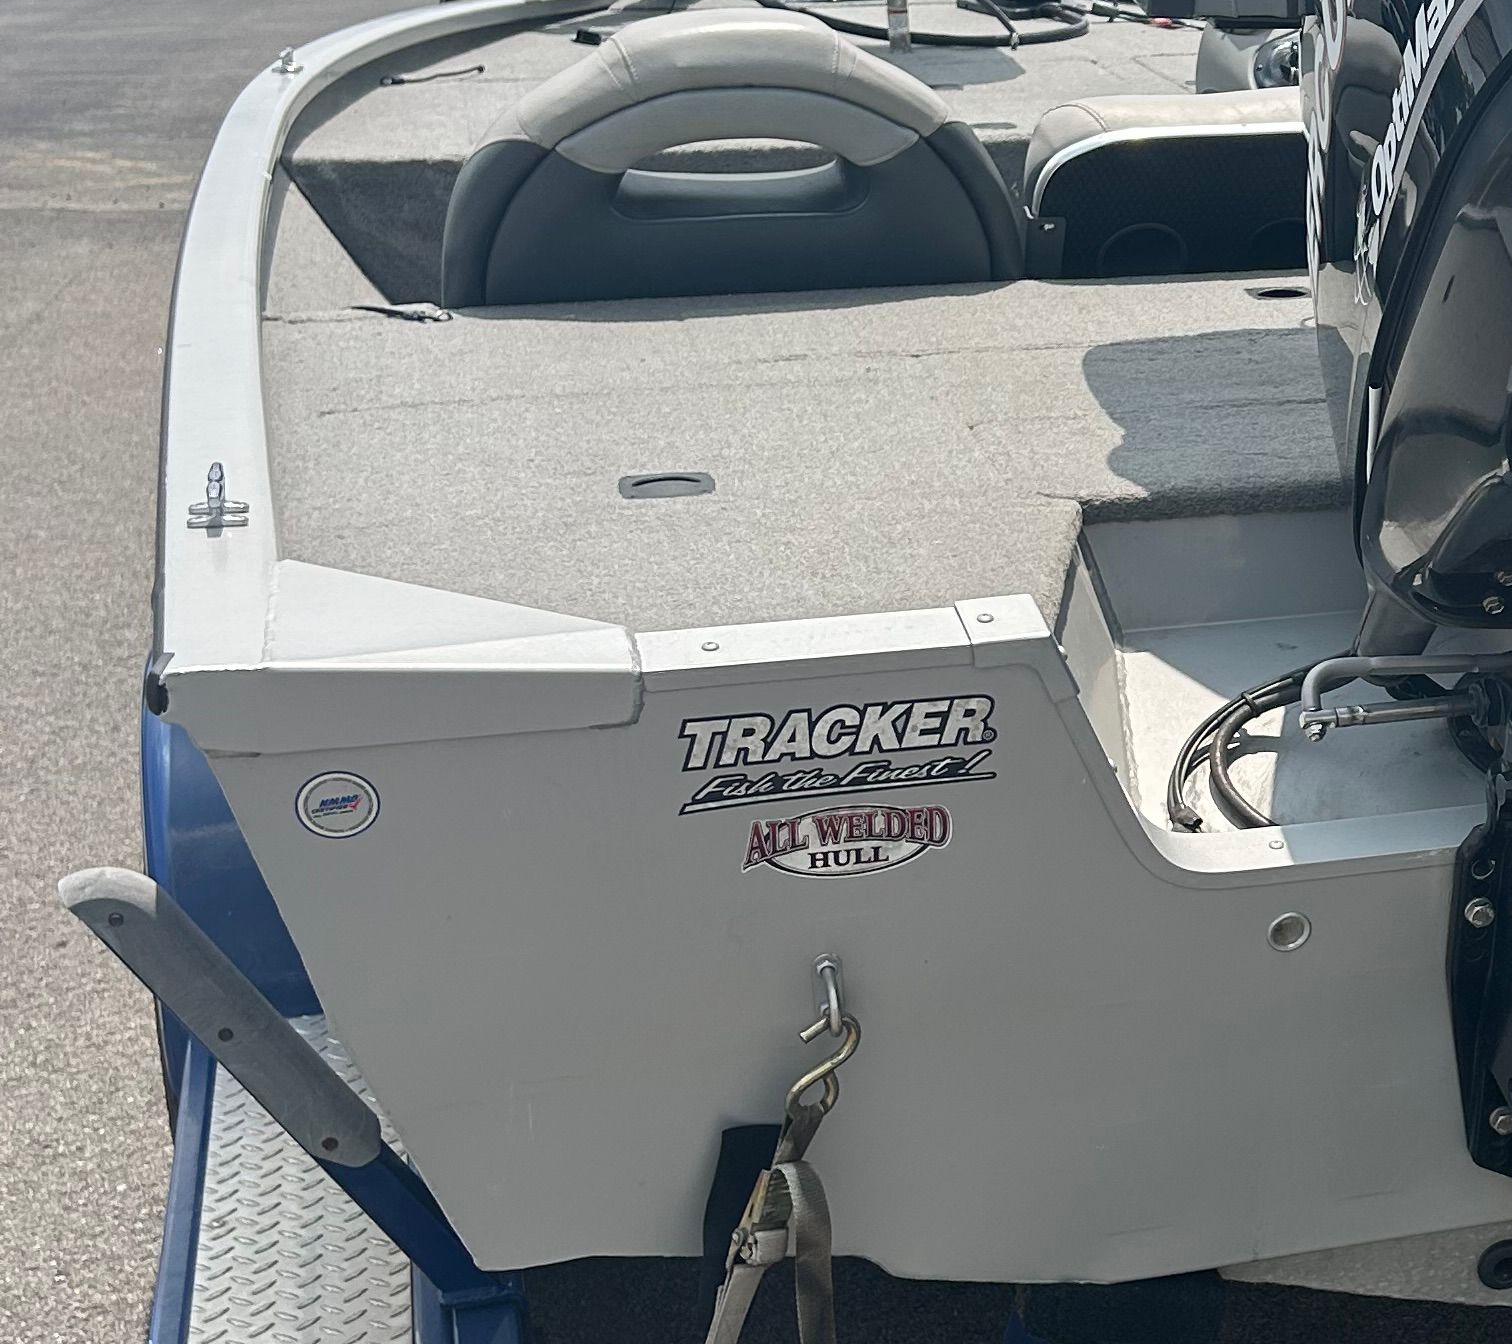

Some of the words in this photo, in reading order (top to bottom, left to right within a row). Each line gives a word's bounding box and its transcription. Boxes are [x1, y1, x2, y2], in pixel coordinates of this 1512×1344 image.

[679, 694, 997, 772] TRACKER
[694, 775, 776, 801] Fish
[782, 769, 837, 790] the
[742, 819, 809, 869] ALL
[814, 806, 951, 847] WELDED
[808, 846, 890, 870] HULL
